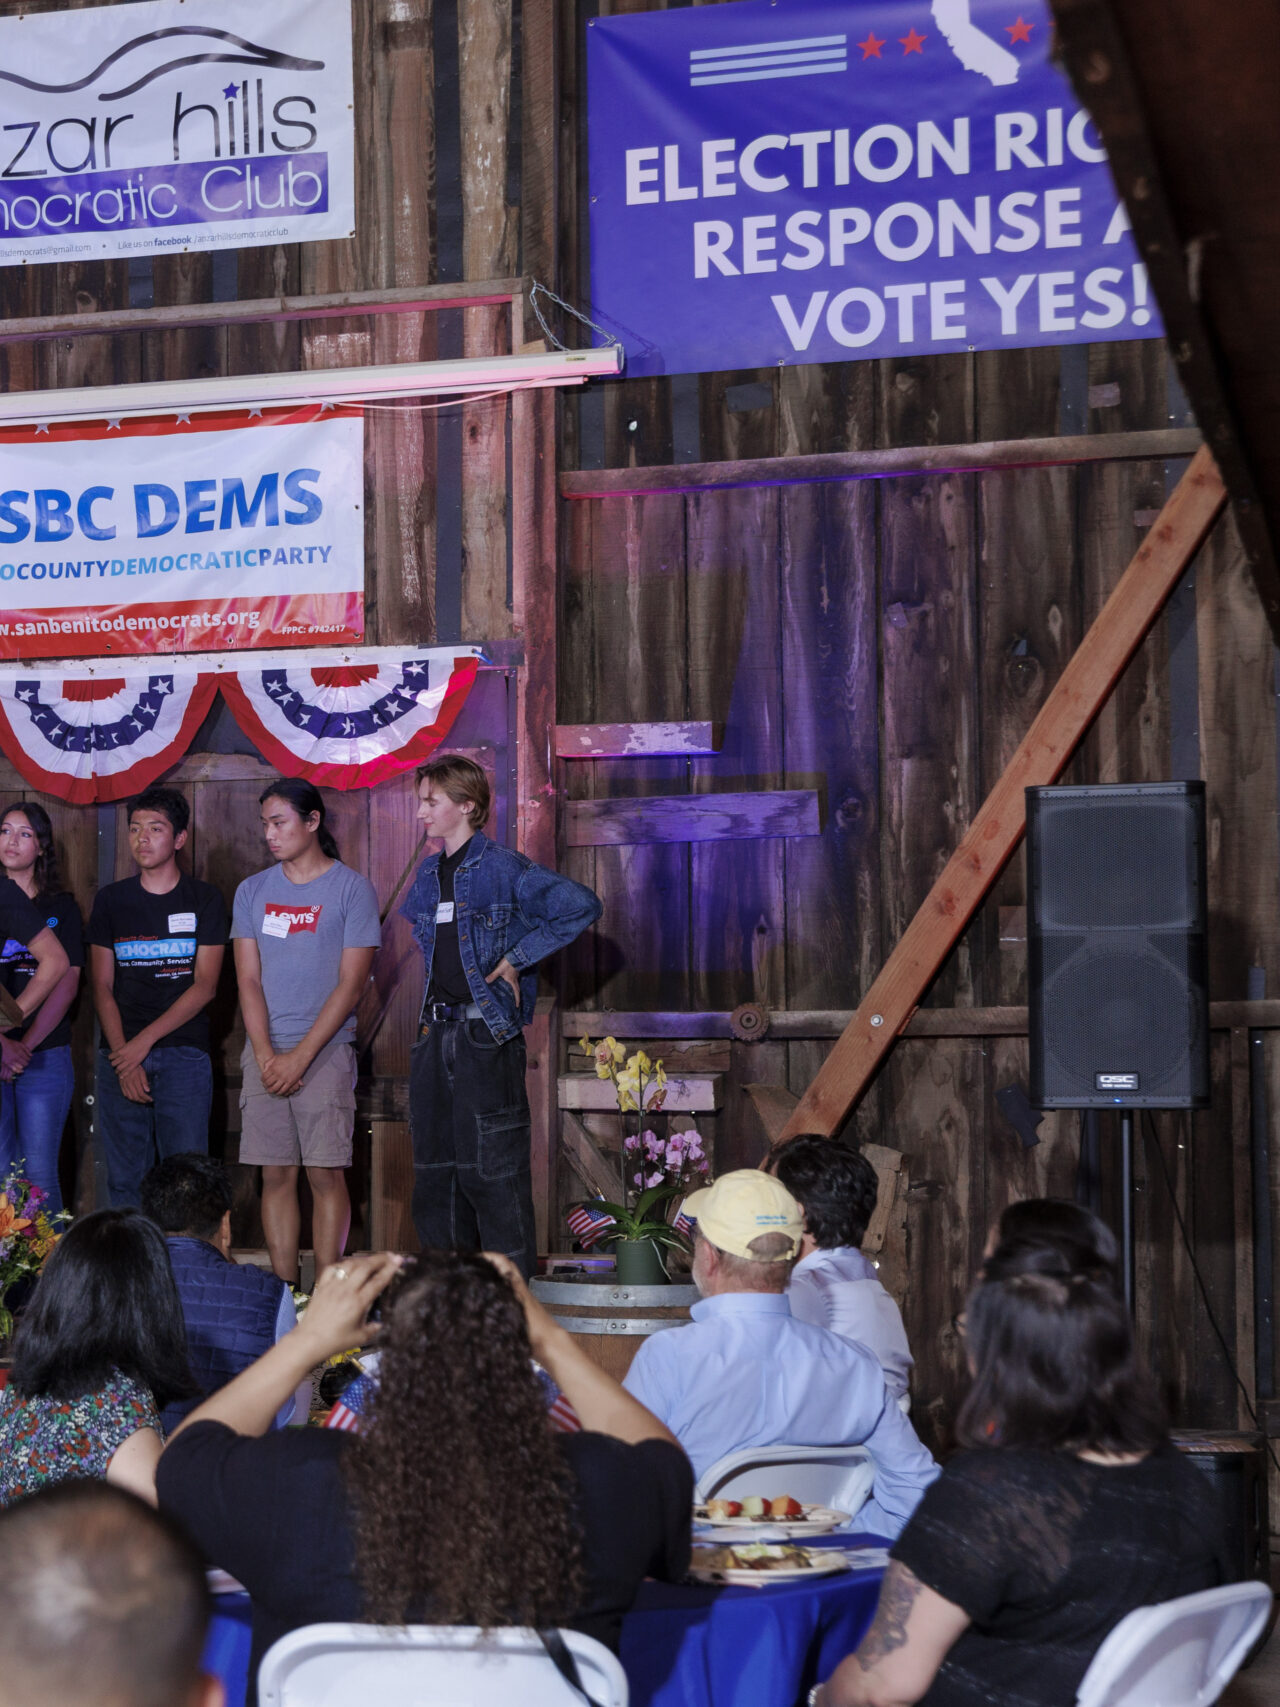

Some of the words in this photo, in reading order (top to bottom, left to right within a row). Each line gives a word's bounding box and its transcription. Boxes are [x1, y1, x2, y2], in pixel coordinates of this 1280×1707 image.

[173, 78, 318, 161] hills
[201, 160, 322, 213] Club
[625, 116, 970, 206] ELECTION
[154, 235, 192, 247] facebook
[693, 187, 1082, 279] RESPONSE
[771, 279, 966, 351] VOTE
[979, 262, 1152, 336] YES!
[134, 468, 323, 539] DEMS
[115, 942, 195, 957] DEMOCRATS
[1100, 1075, 1135, 1083] QSC
